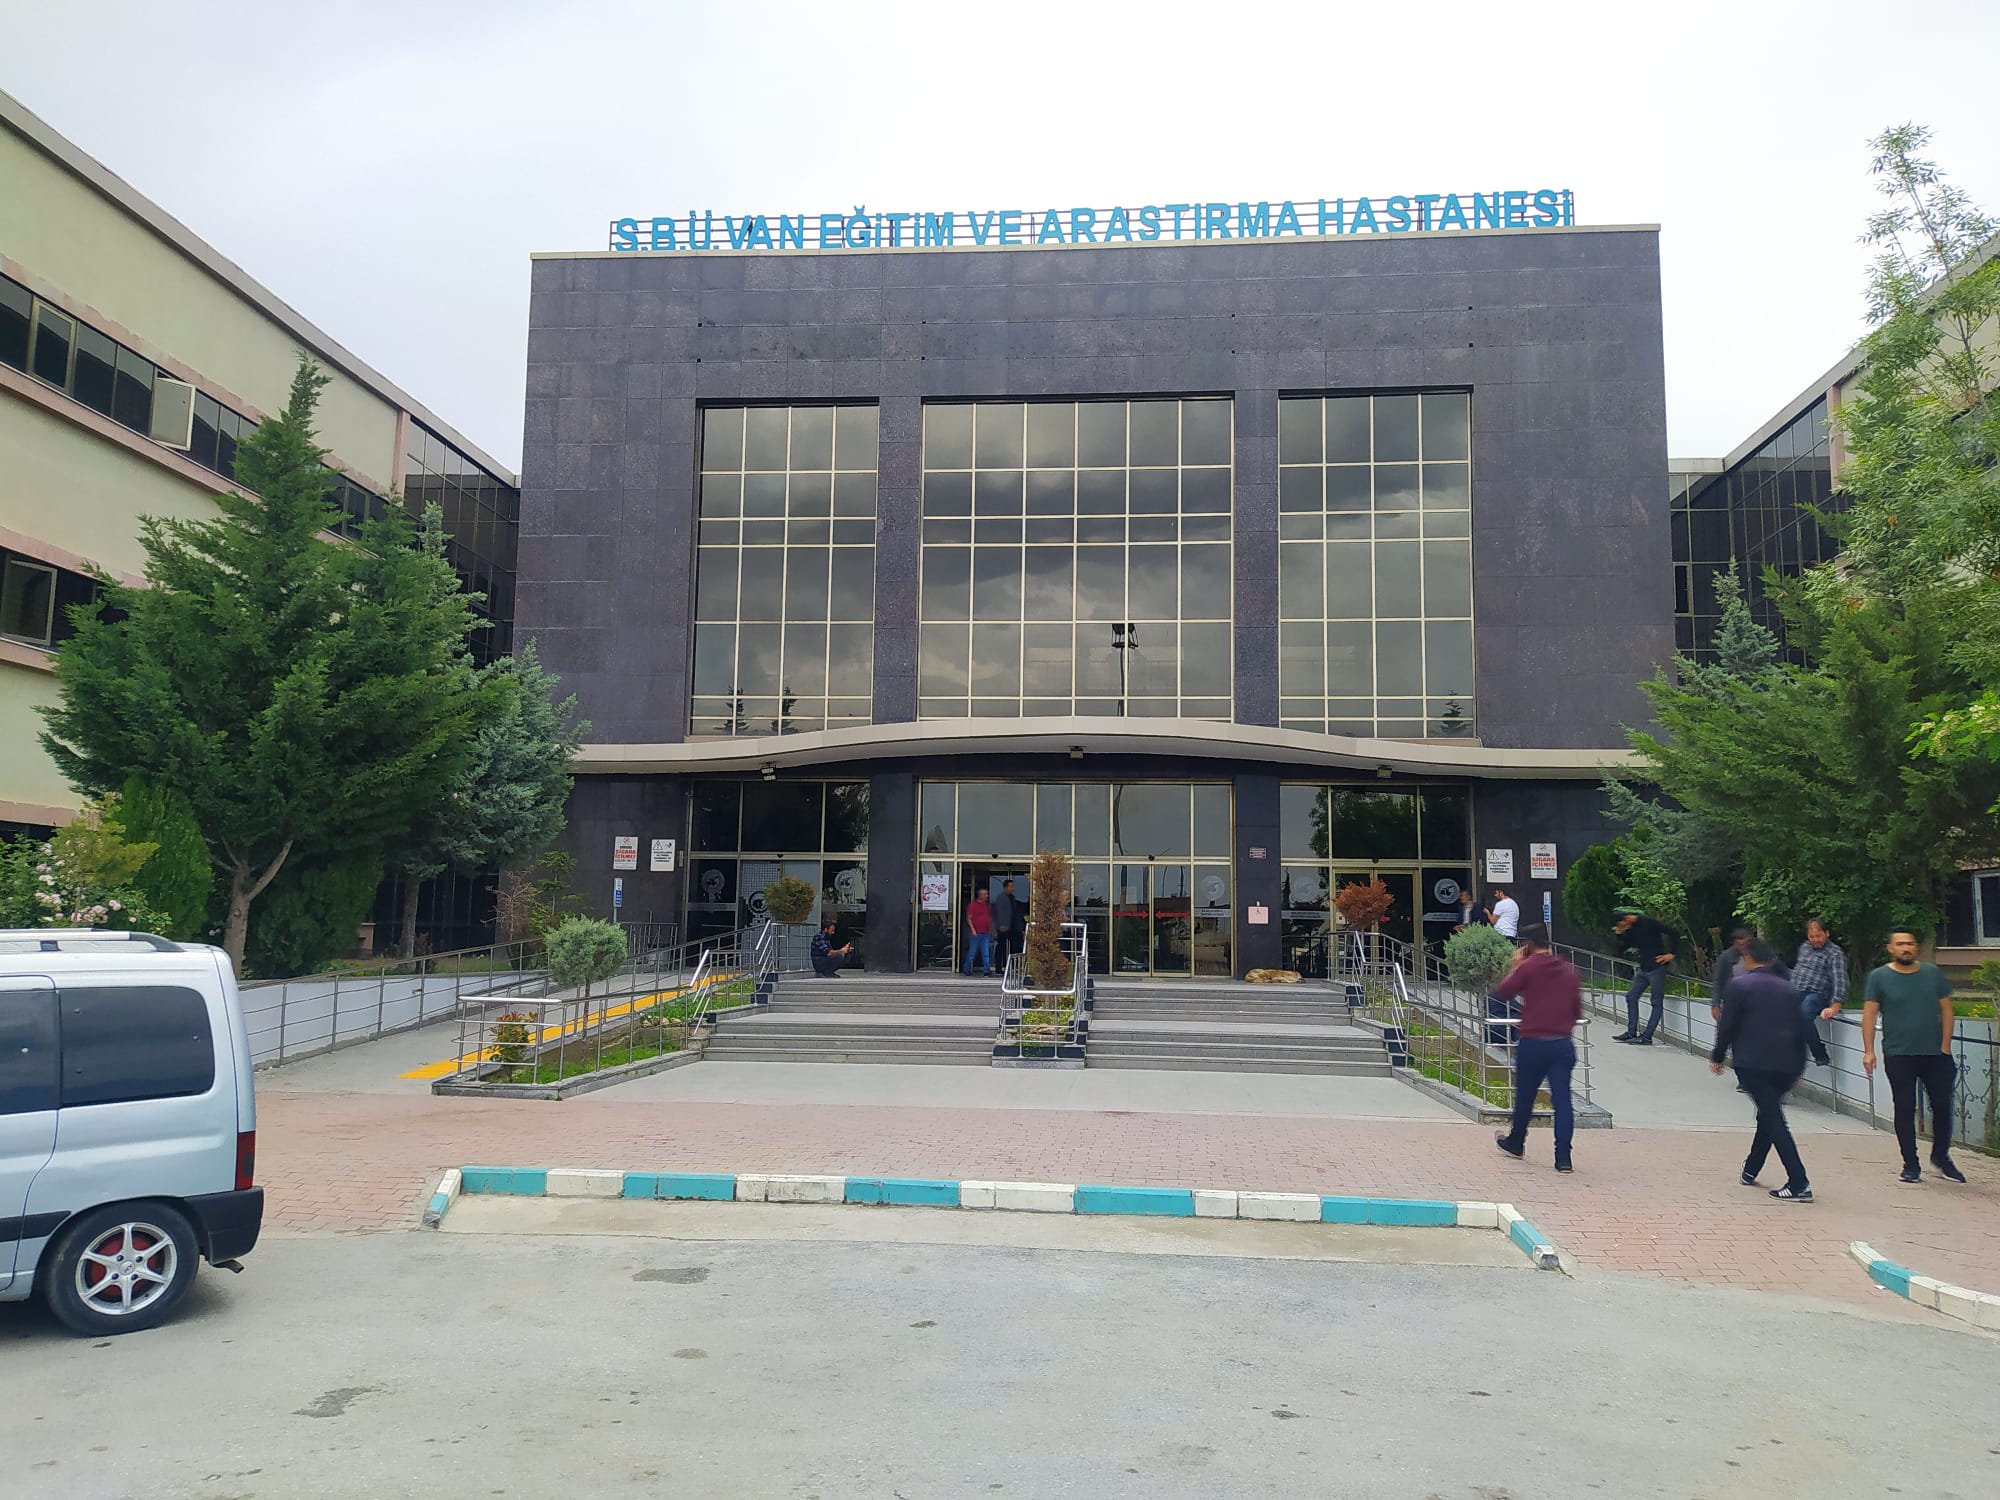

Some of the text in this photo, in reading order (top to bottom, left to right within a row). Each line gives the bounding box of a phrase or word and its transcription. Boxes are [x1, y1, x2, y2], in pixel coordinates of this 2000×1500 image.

[724, 214, 804, 251] VAN
[819, 204, 955, 249] EĞİTİM
[967, 210, 1022, 246] VE
[1317, 188, 1571, 236] HASTANESİ
